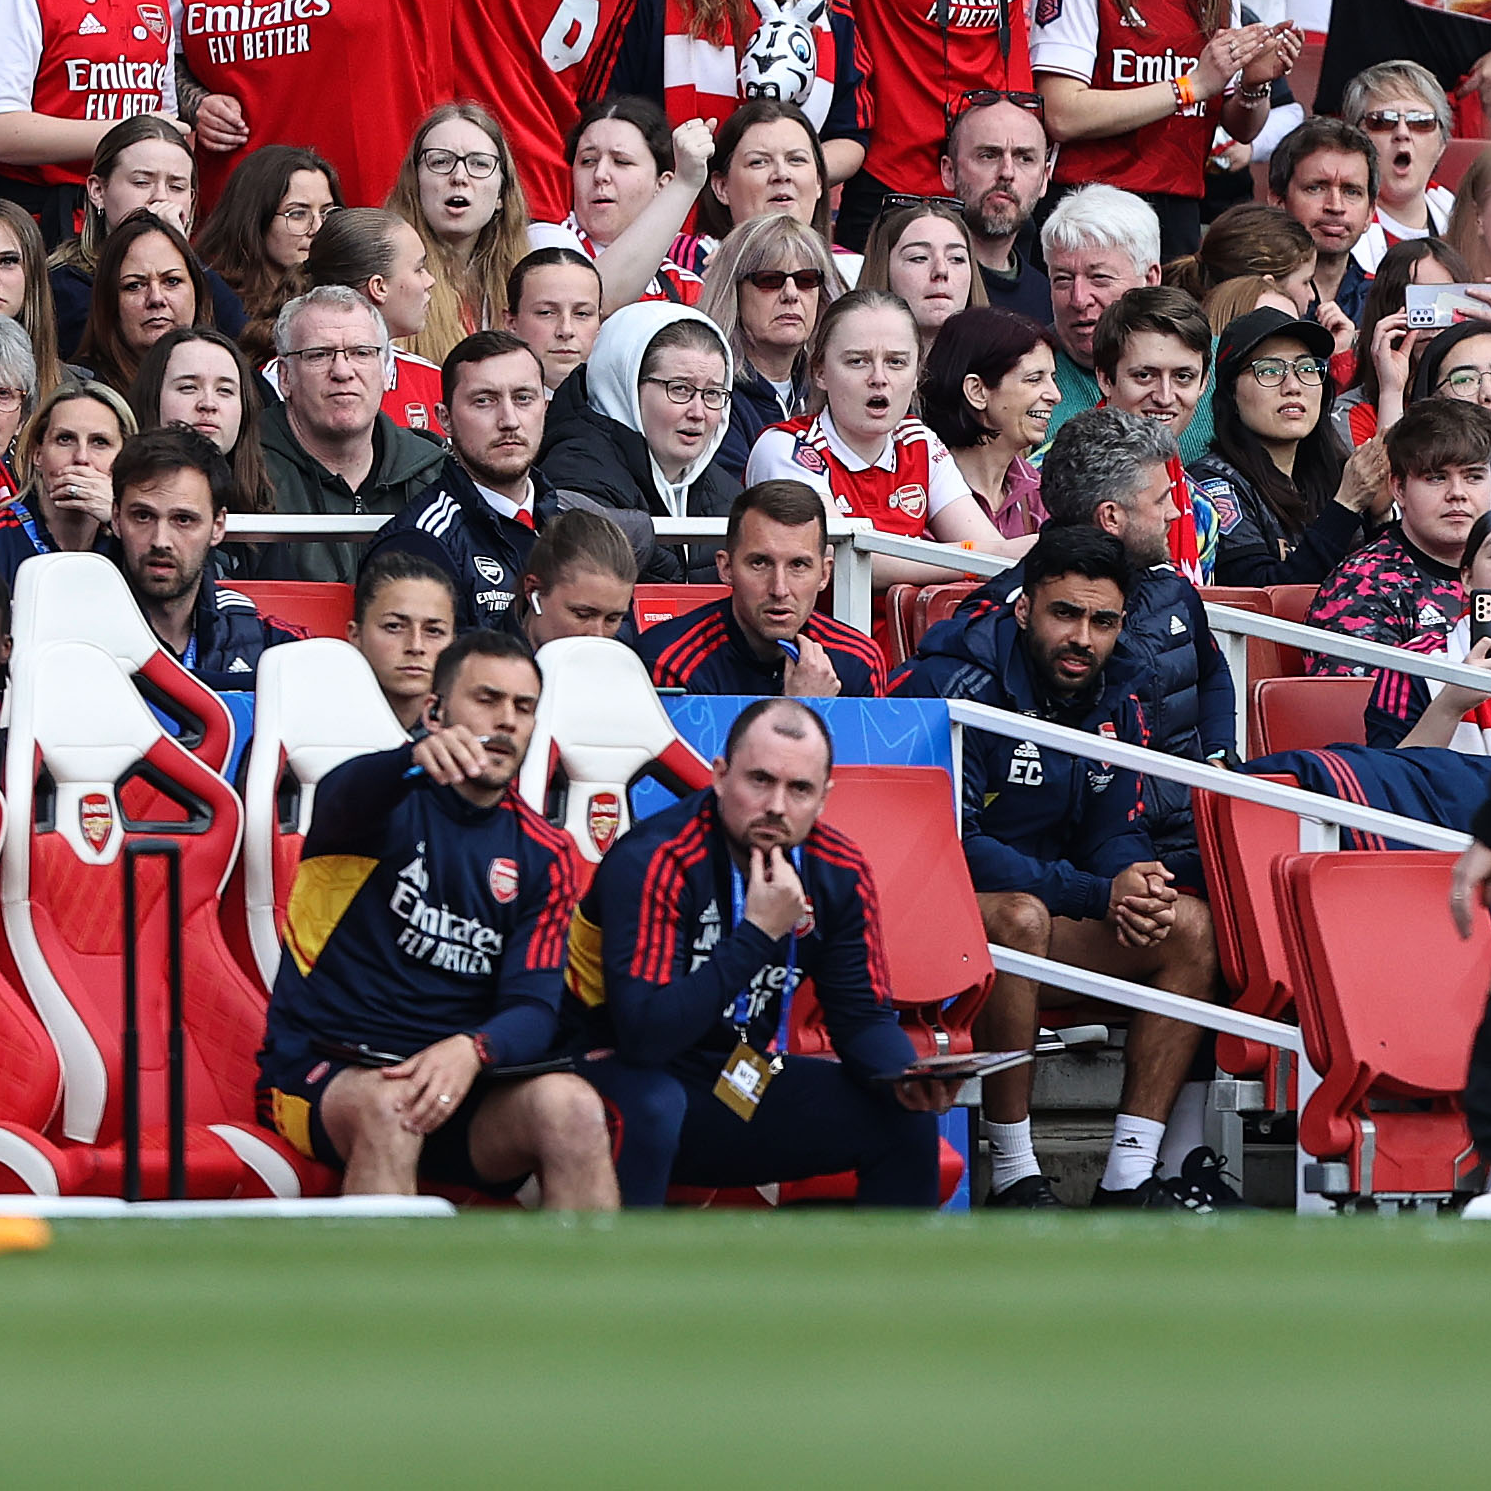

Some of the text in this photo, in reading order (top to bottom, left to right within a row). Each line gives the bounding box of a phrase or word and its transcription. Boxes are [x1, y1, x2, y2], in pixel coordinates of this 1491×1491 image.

[208, 23, 311, 64] FLY BETTER
[85, 93, 118, 120] FLY
[1007, 758, 1043, 786] EC
[389, 880, 504, 956] Emirates
[396, 926, 431, 960] FLY
